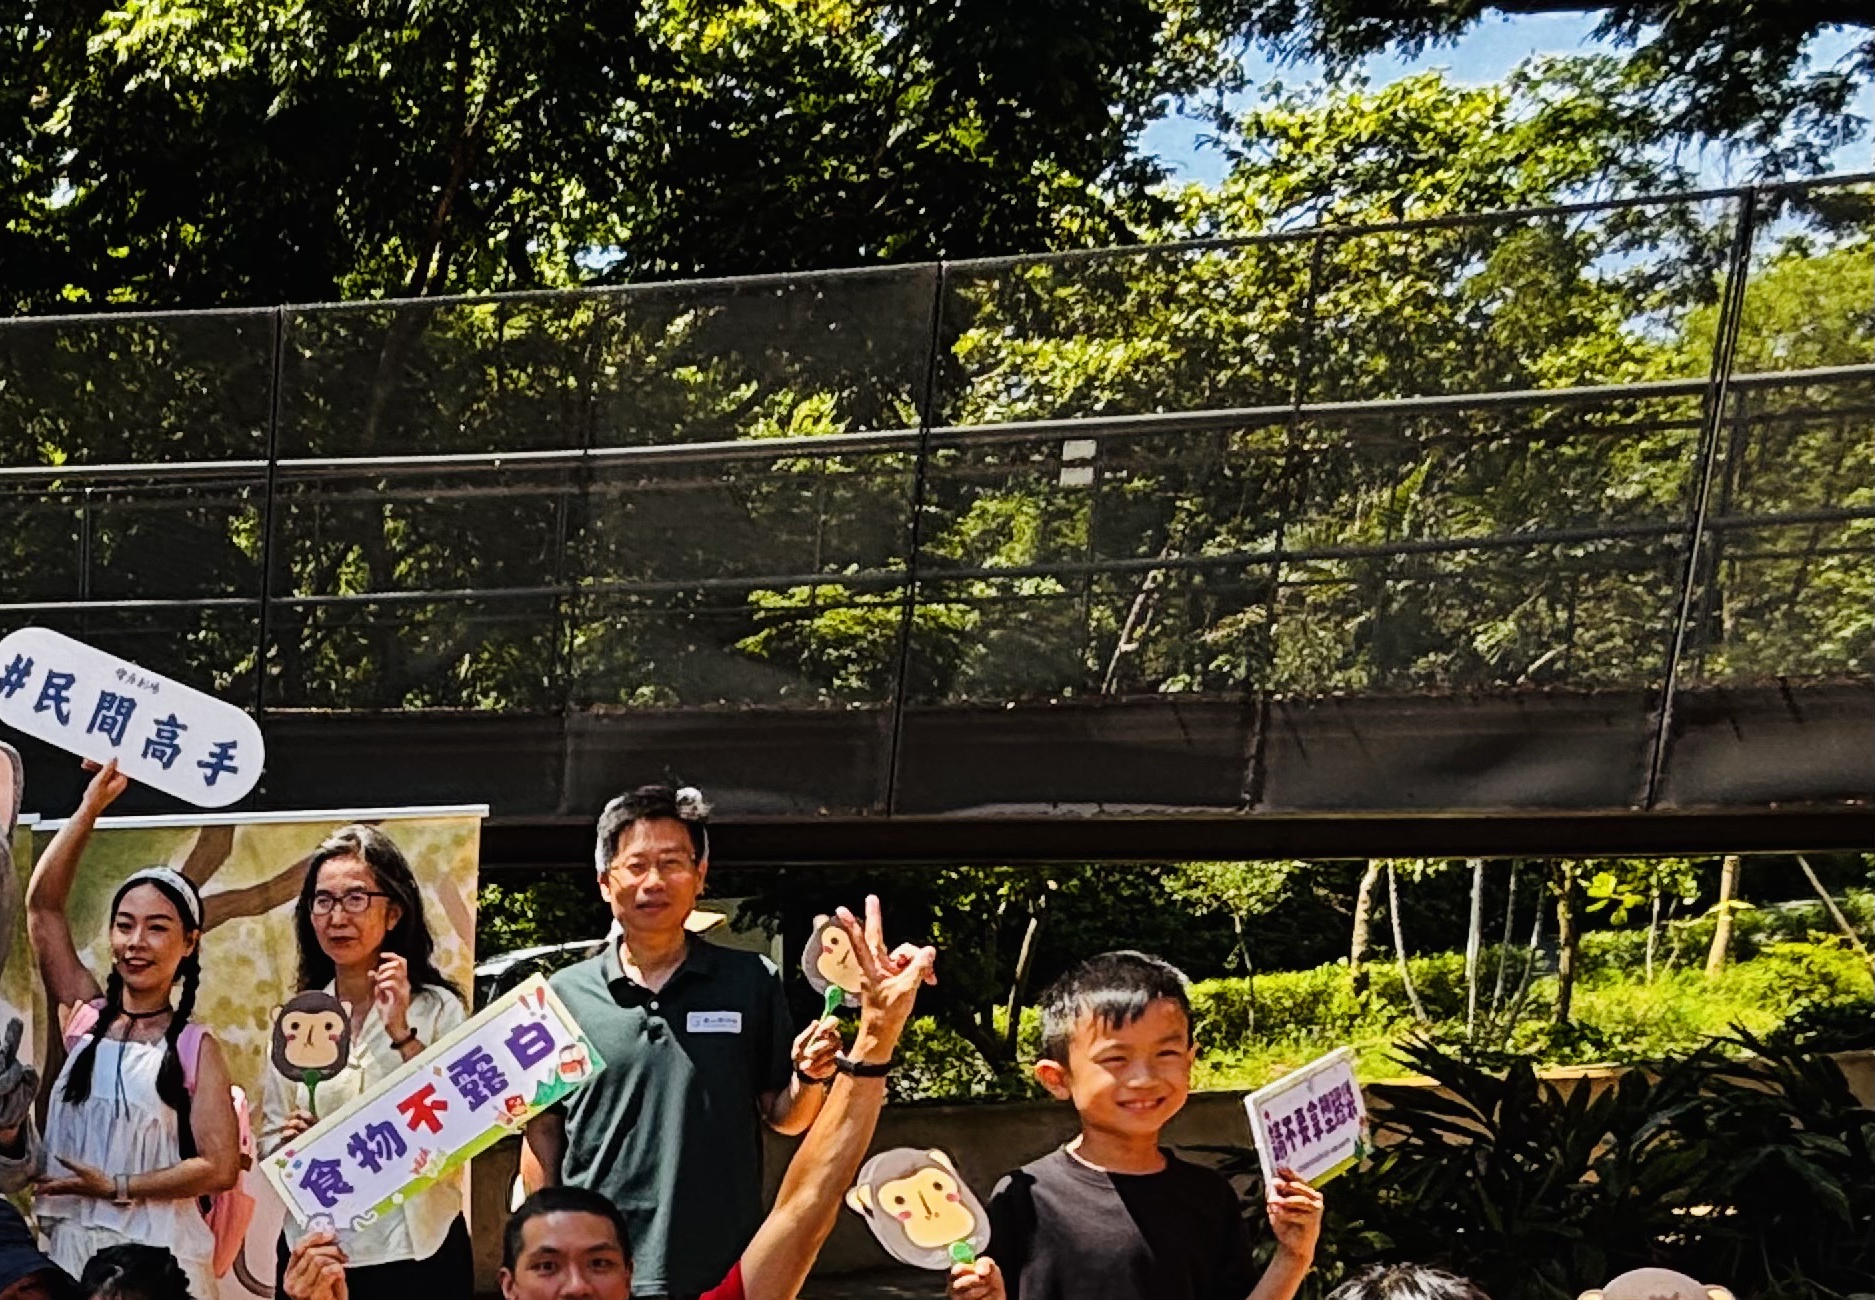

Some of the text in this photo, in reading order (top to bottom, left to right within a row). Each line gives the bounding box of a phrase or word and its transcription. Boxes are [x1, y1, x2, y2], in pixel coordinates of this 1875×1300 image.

[299, 1021, 556, 1208] 食物不露白
